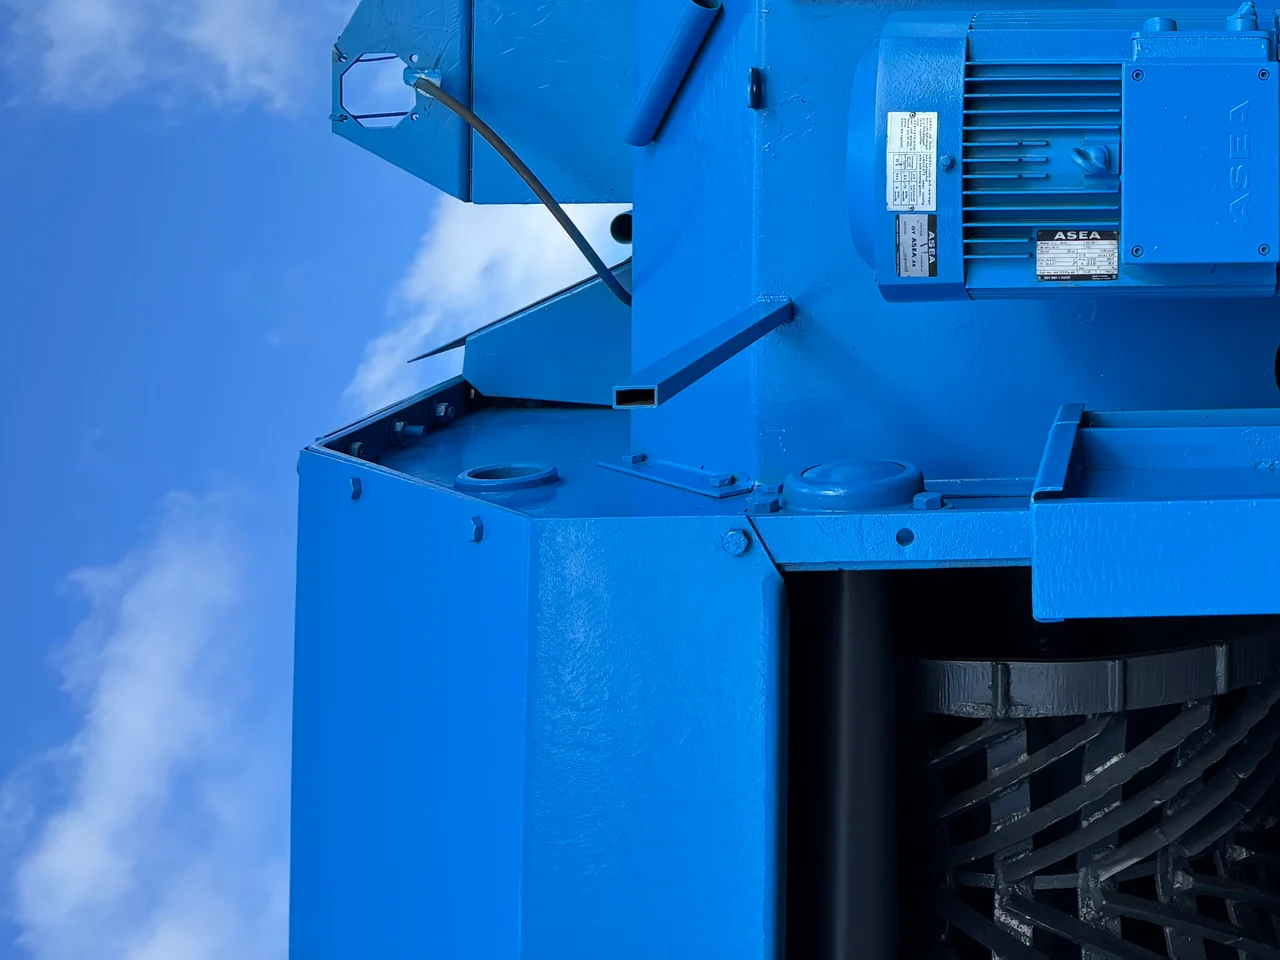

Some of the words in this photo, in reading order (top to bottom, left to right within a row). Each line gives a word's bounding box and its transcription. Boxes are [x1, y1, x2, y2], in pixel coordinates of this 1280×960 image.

[1229, 100, 1251, 225] ASEA
[928, 230, 936, 264] ASEA
[1054, 231, 1101, 240] ASEA
